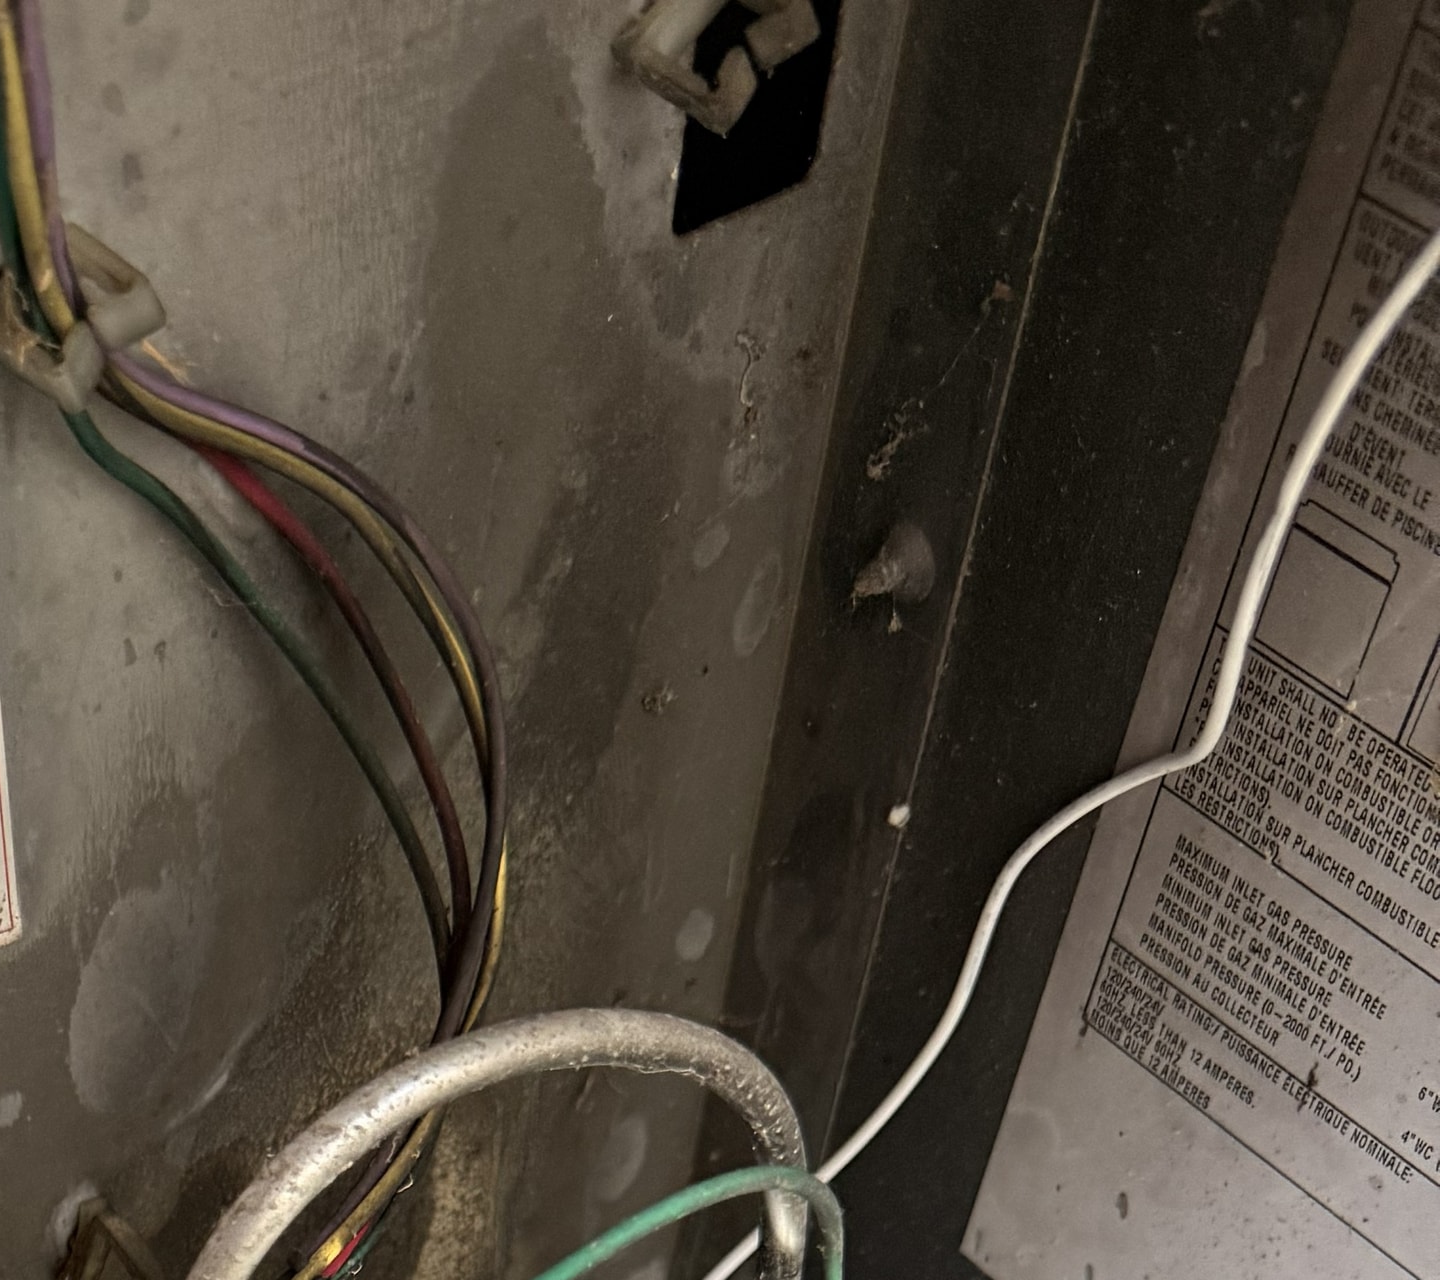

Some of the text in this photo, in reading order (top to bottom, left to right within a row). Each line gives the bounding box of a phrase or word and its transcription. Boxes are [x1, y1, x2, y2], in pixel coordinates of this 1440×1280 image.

[1168, 847, 1226, 904] PRESSION
[1220, 890, 1243, 918] DE
[1265, 921, 1330, 978] MAXIMALE
[1326, 966, 1388, 1021] D'ENTRÉE
[1174, 832, 1354, 973] MAXIMUM INLET GAS PRESSURE
[1138, 930, 1283, 1048] PRESSION AU COLLECTEUR
[1147, 910, 1206, 963] MANIFOLD
[1202, 950, 1264, 1008] PRESSURE
[1335, 1049, 1362, 1083] PD.)
